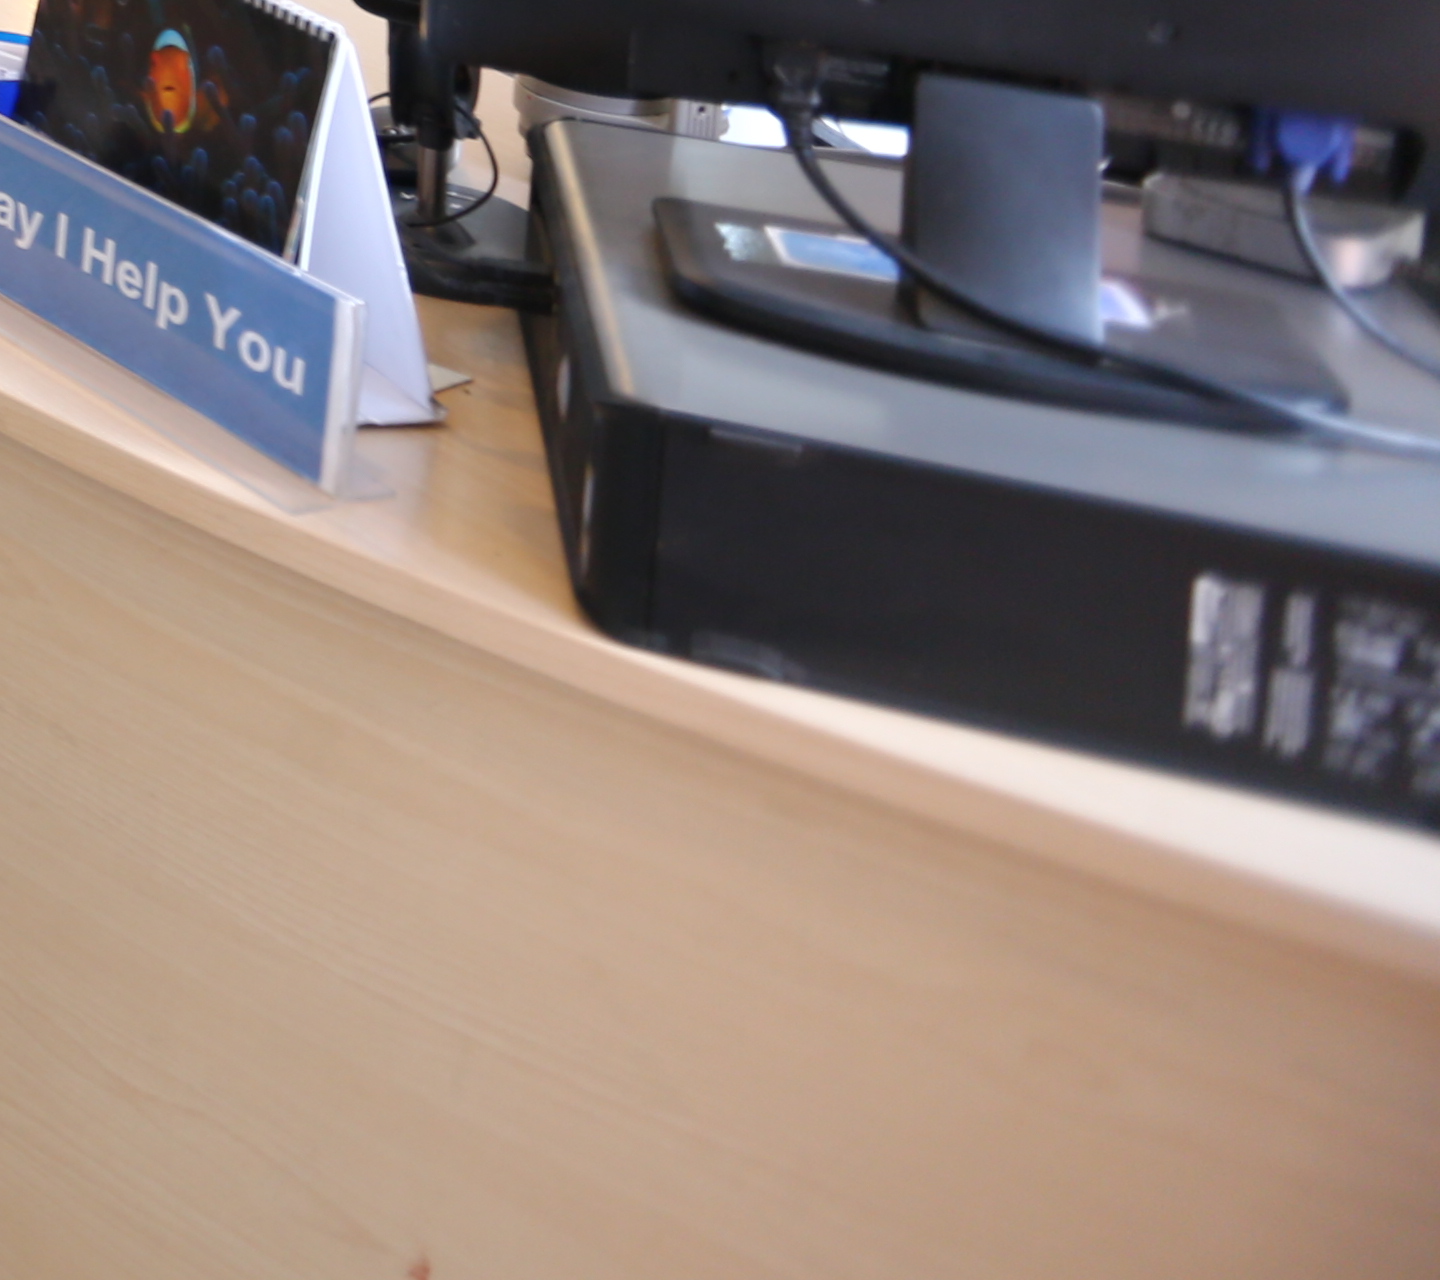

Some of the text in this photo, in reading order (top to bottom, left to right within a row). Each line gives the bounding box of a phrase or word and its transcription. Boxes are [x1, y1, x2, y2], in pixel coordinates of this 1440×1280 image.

[54, 213, 68, 259] I
[81, 226, 190, 330] Help
[204, 292, 306, 397] You
